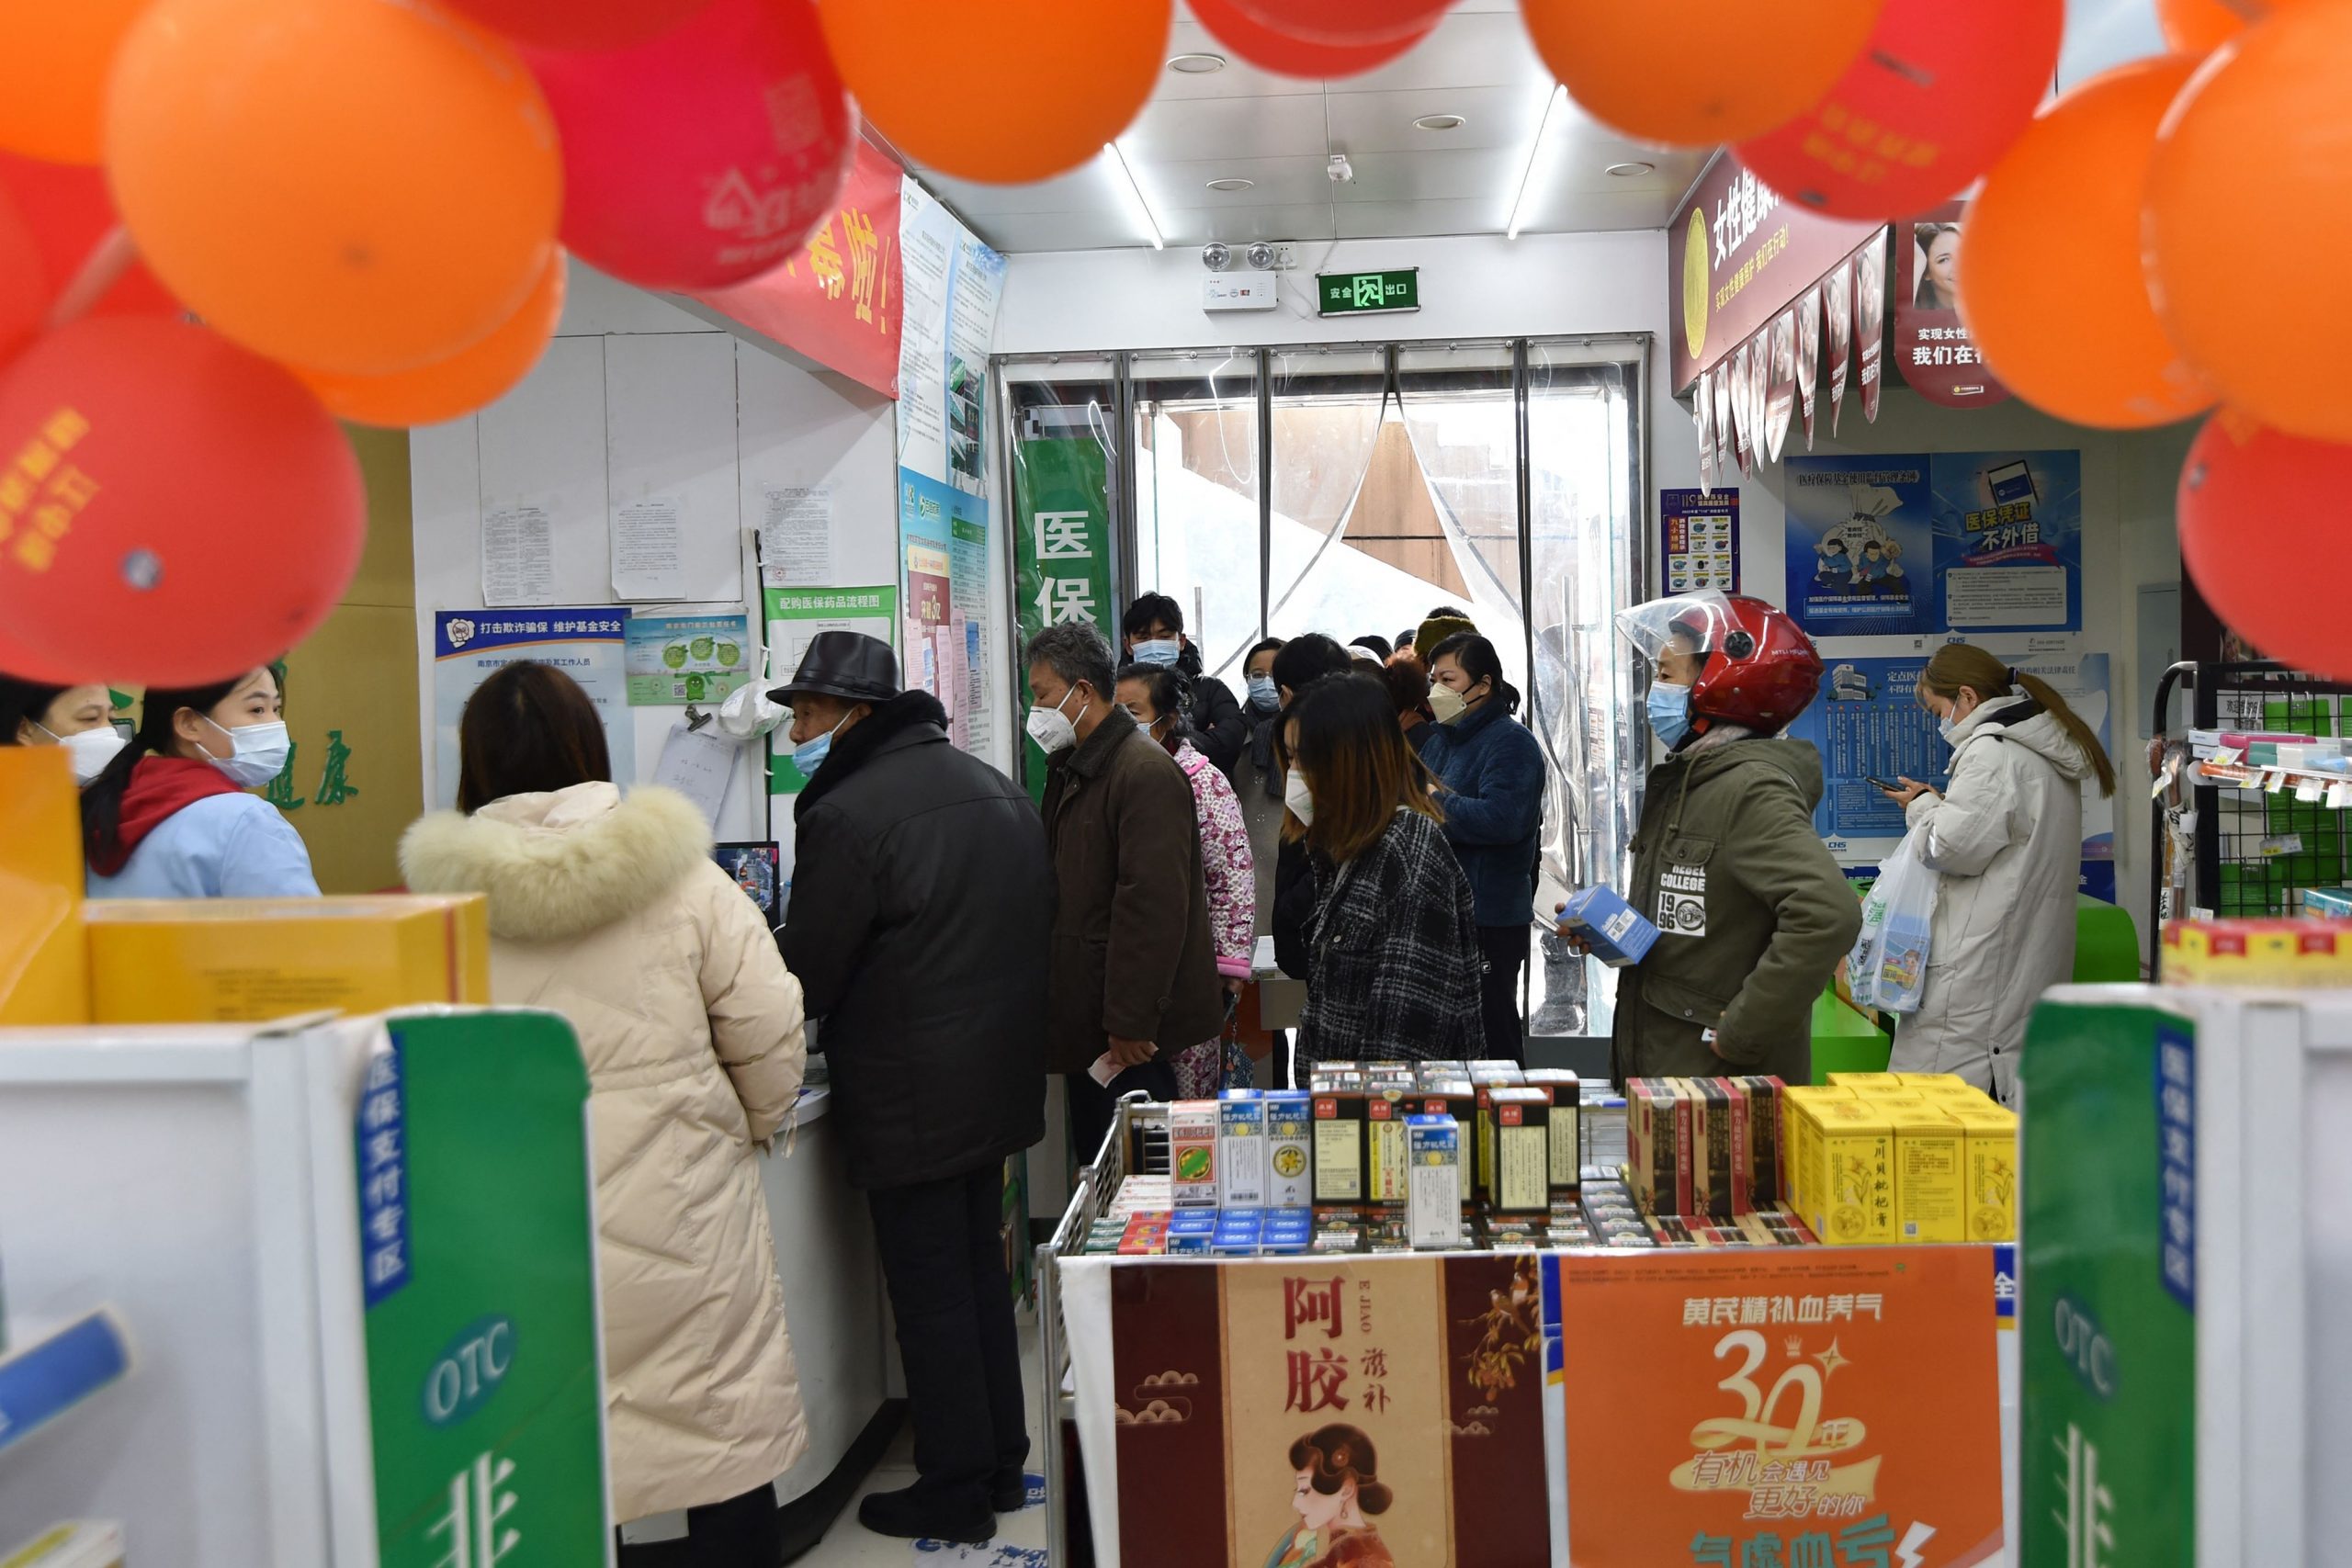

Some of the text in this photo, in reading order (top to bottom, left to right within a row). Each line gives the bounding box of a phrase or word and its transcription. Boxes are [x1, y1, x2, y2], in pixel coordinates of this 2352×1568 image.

[1330, 283, 1408, 299] 安全 出口
[1965, 502, 2031, 533] 医保凭证
[1982, 523, 2040, 550] 不外借
[1034, 511, 1098, 627] 医保
[780, 595, 880, 610] 配购医保药品流程图
[481, 620, 622, 634] 打击欺诈骗保 维护基金安全
[1660, 874, 1706, 892] COLLEGE
[1661, 894, 1675, 912] 19
[1658, 912, 1675, 930] 96
[368, 1050, 406, 1285] 医保支付专区
[1874, 1145, 1889, 1227] 川贝枇杷膏
[1995, 1271, 2015, 1298] 全
[1359, 1280, 1372, 1333] E JIAO
[1682, 1293, 1883, 1325] 黄芪精补血养气
[1283, 1275, 1351, 1413] 阿胶
[2055, 1297, 2112, 1396] OTC
[429, 1321, 510, 1424] OTC
[1361, 1347, 1392, 1416] 滋补
[1692, 1450, 1829, 1485] 有机会遇见
[1743, 1485, 1867, 1518] 更好的你
